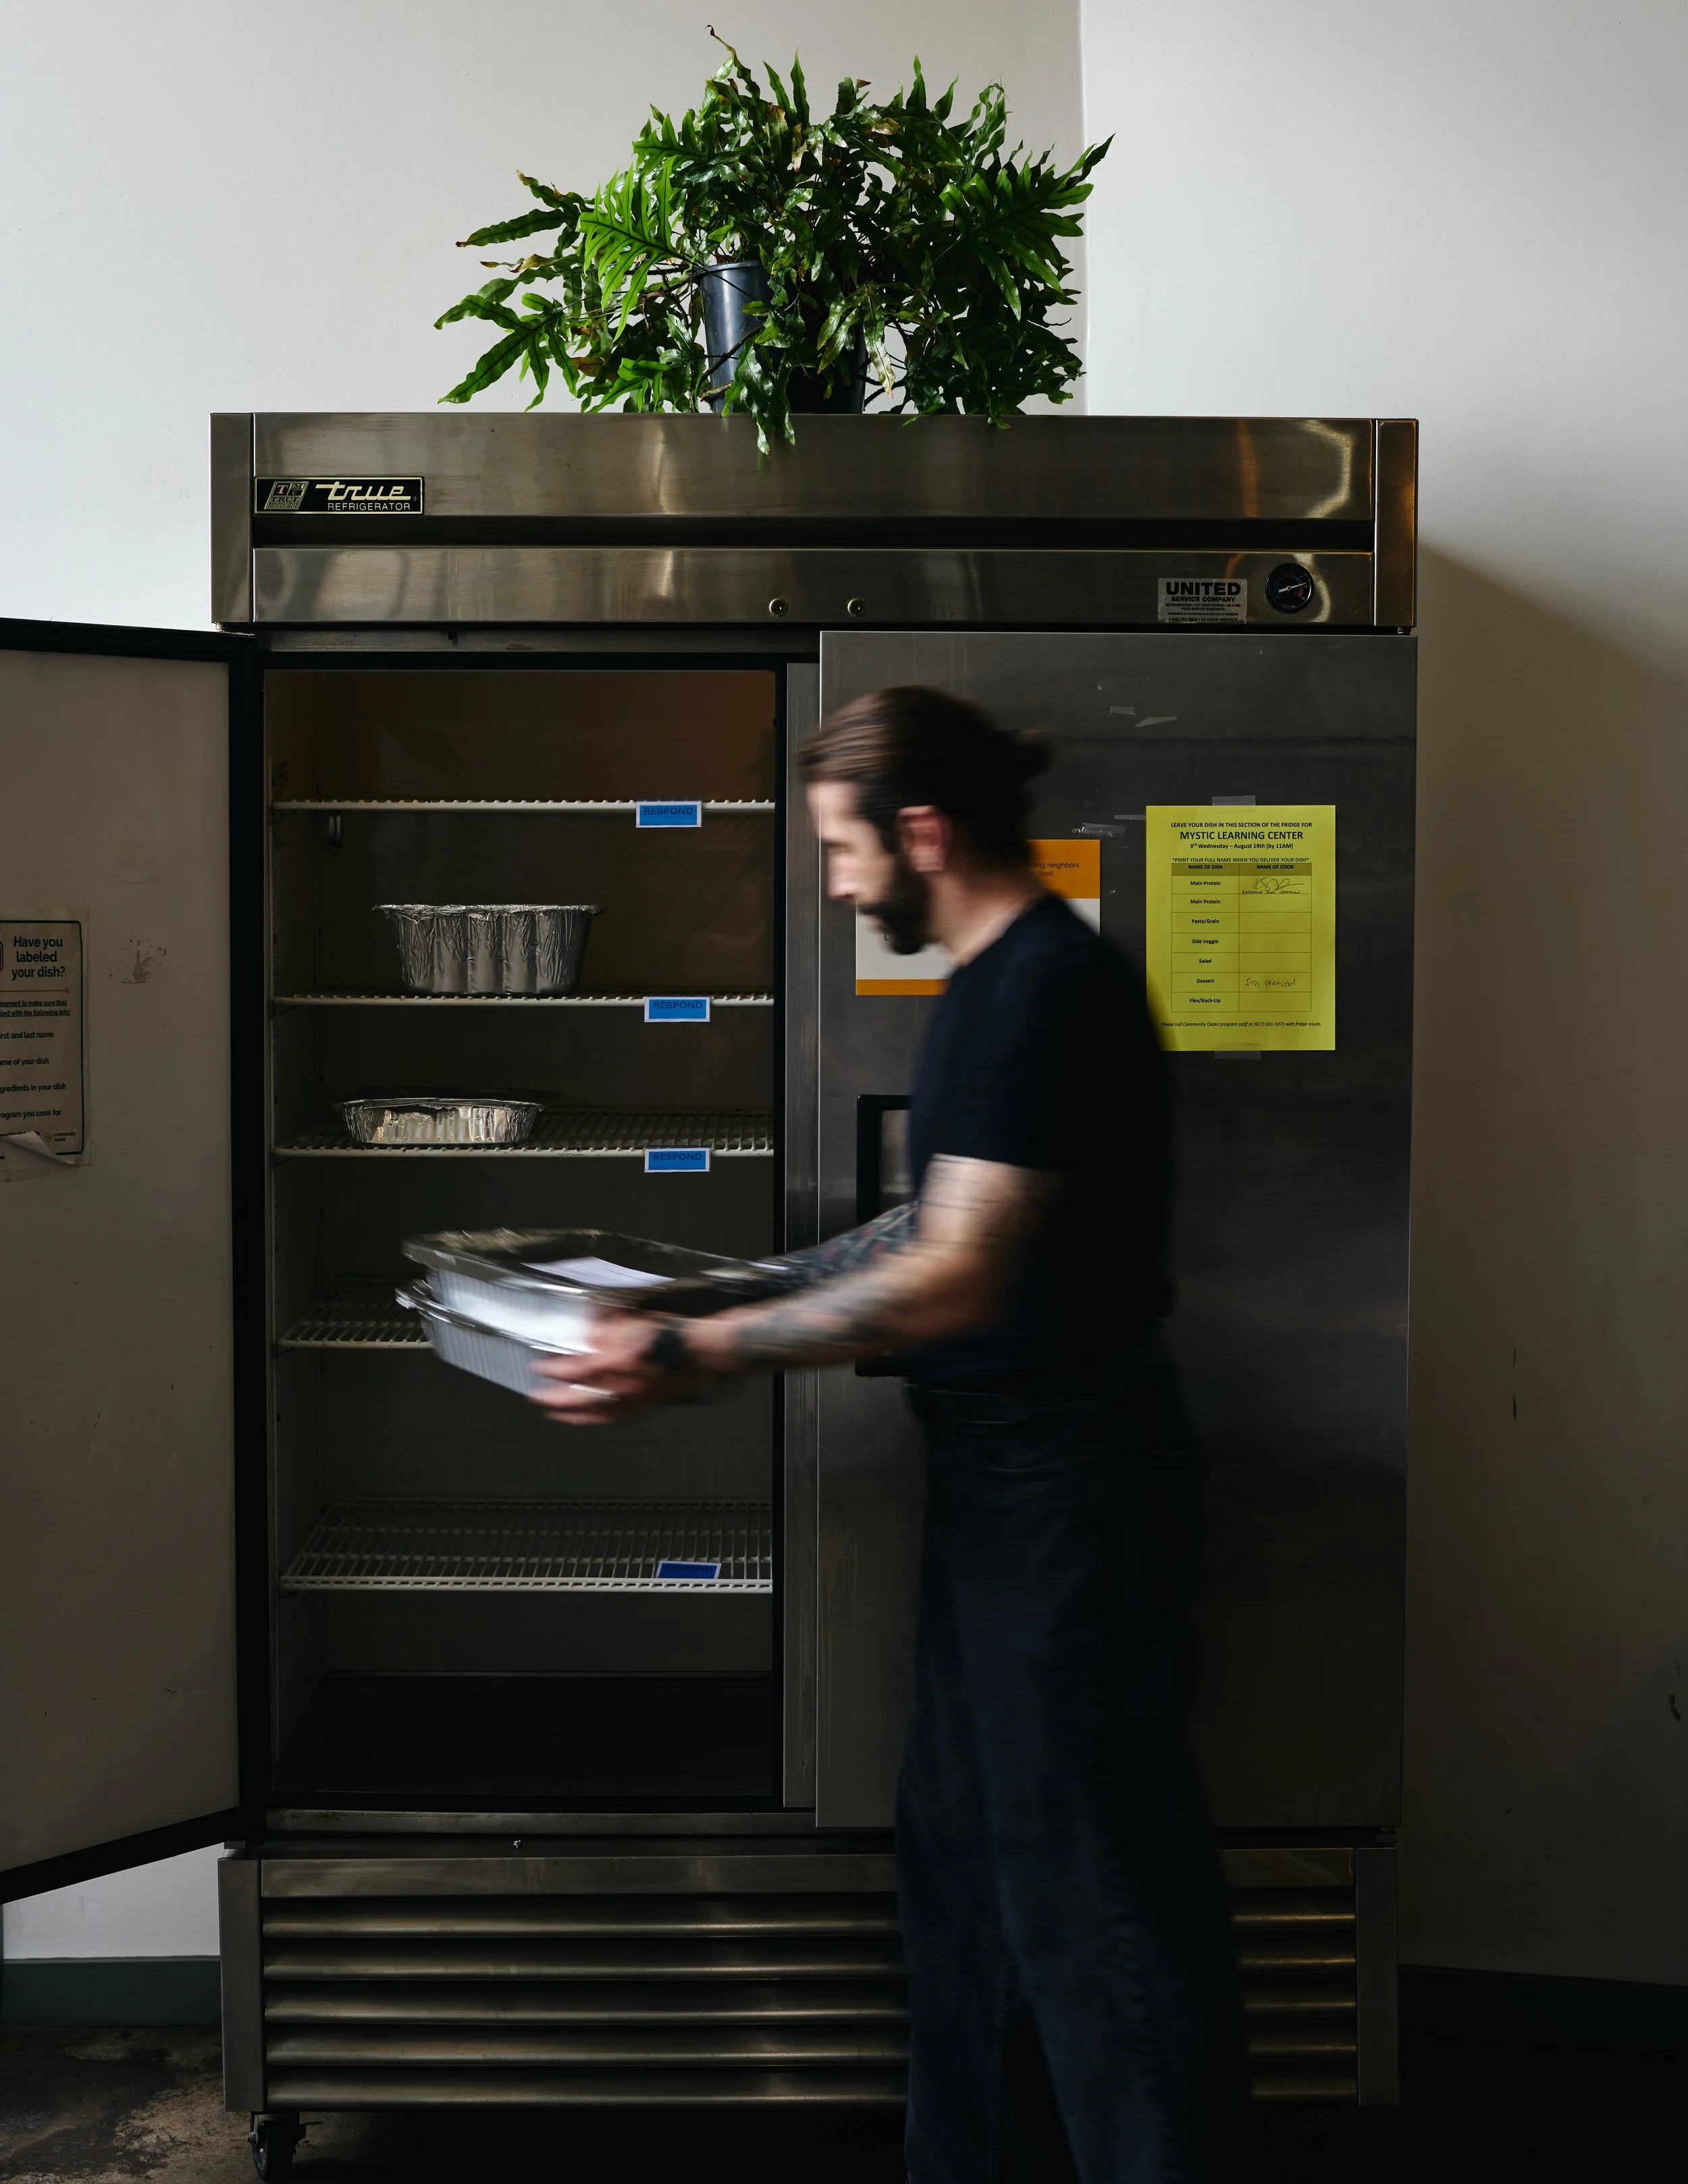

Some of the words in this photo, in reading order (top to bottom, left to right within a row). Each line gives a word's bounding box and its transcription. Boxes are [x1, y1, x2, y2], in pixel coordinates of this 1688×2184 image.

[315, 481, 411, 501] true
[328, 503, 410, 511] REFRIGERATOR
[1166, 582, 1241, 595] UNITED
[1180, 831, 1215, 840] MYSTIC
[1218, 831, 1265, 840] LEARNING
[1268, 831, 1303, 839] CENTER
[14, 936, 41, 947] Have
[43, 939, 63, 950] you
[16, 951, 57, 962] labeled
[11, 969, 35, 981] your
[37, 966, 65, 977] dish?
